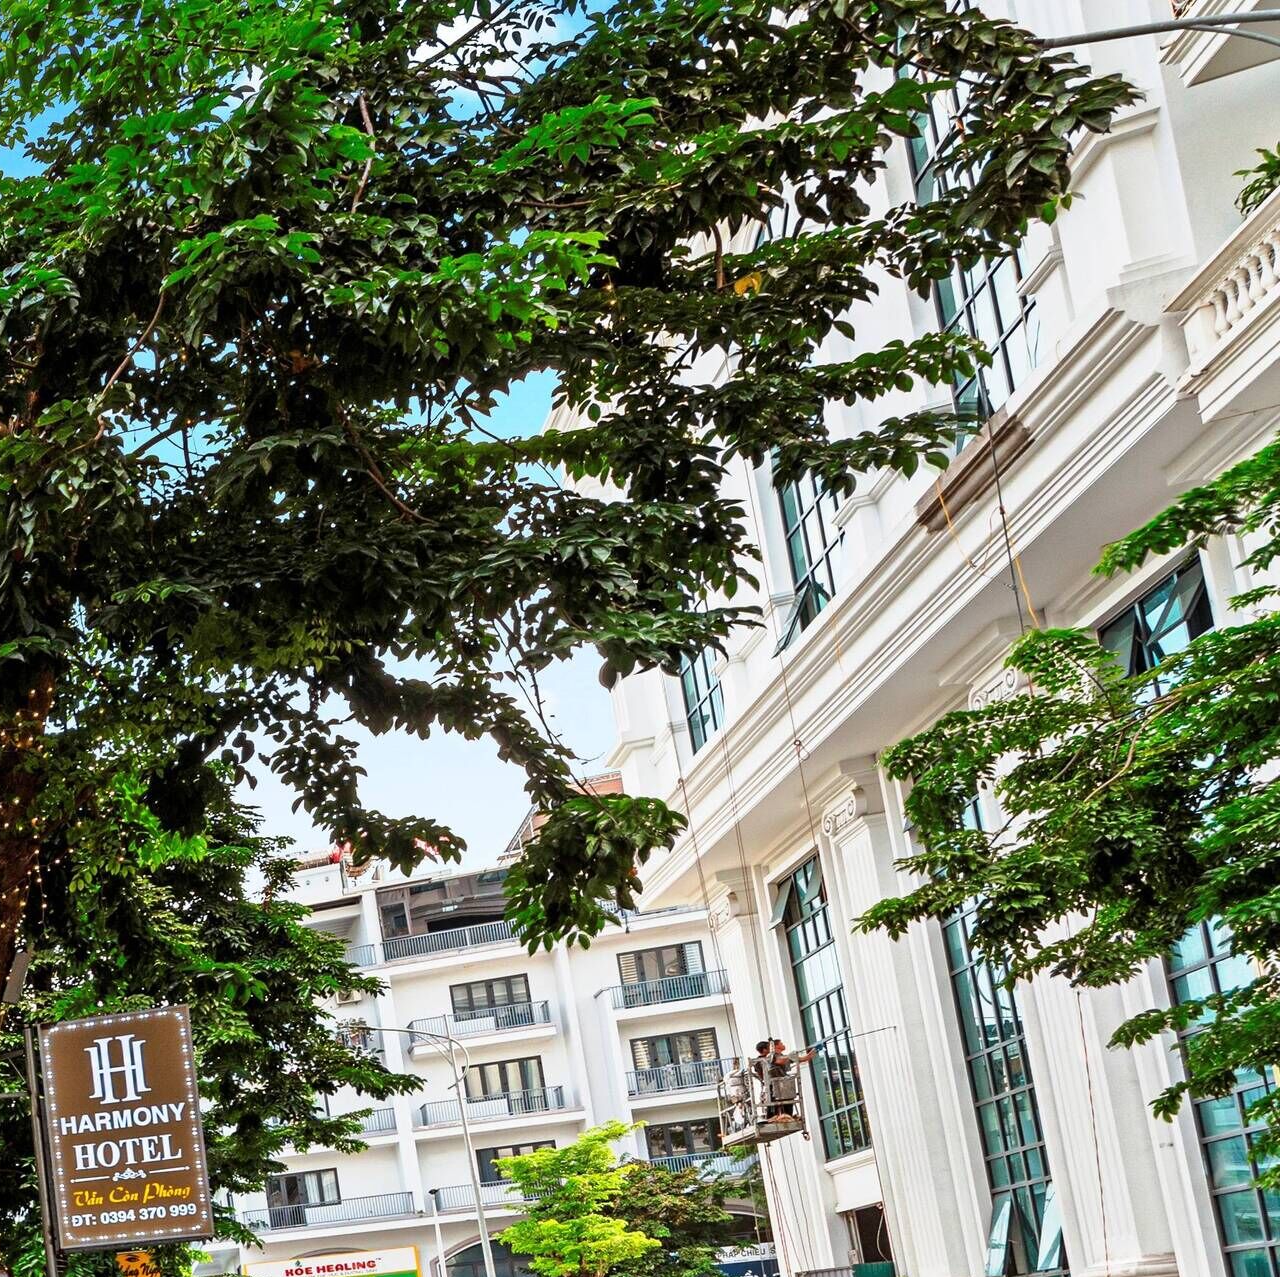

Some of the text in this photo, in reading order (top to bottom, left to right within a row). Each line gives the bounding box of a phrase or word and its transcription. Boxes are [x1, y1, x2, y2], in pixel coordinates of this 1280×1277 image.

[61, 1102, 186, 1136] HARMONY
[73, 1133, 183, 1170] HOTEL
[71, 1203, 197, 1227] ĐT: 0394 370 999
[316, 1260, 376, 1274] HEALING
